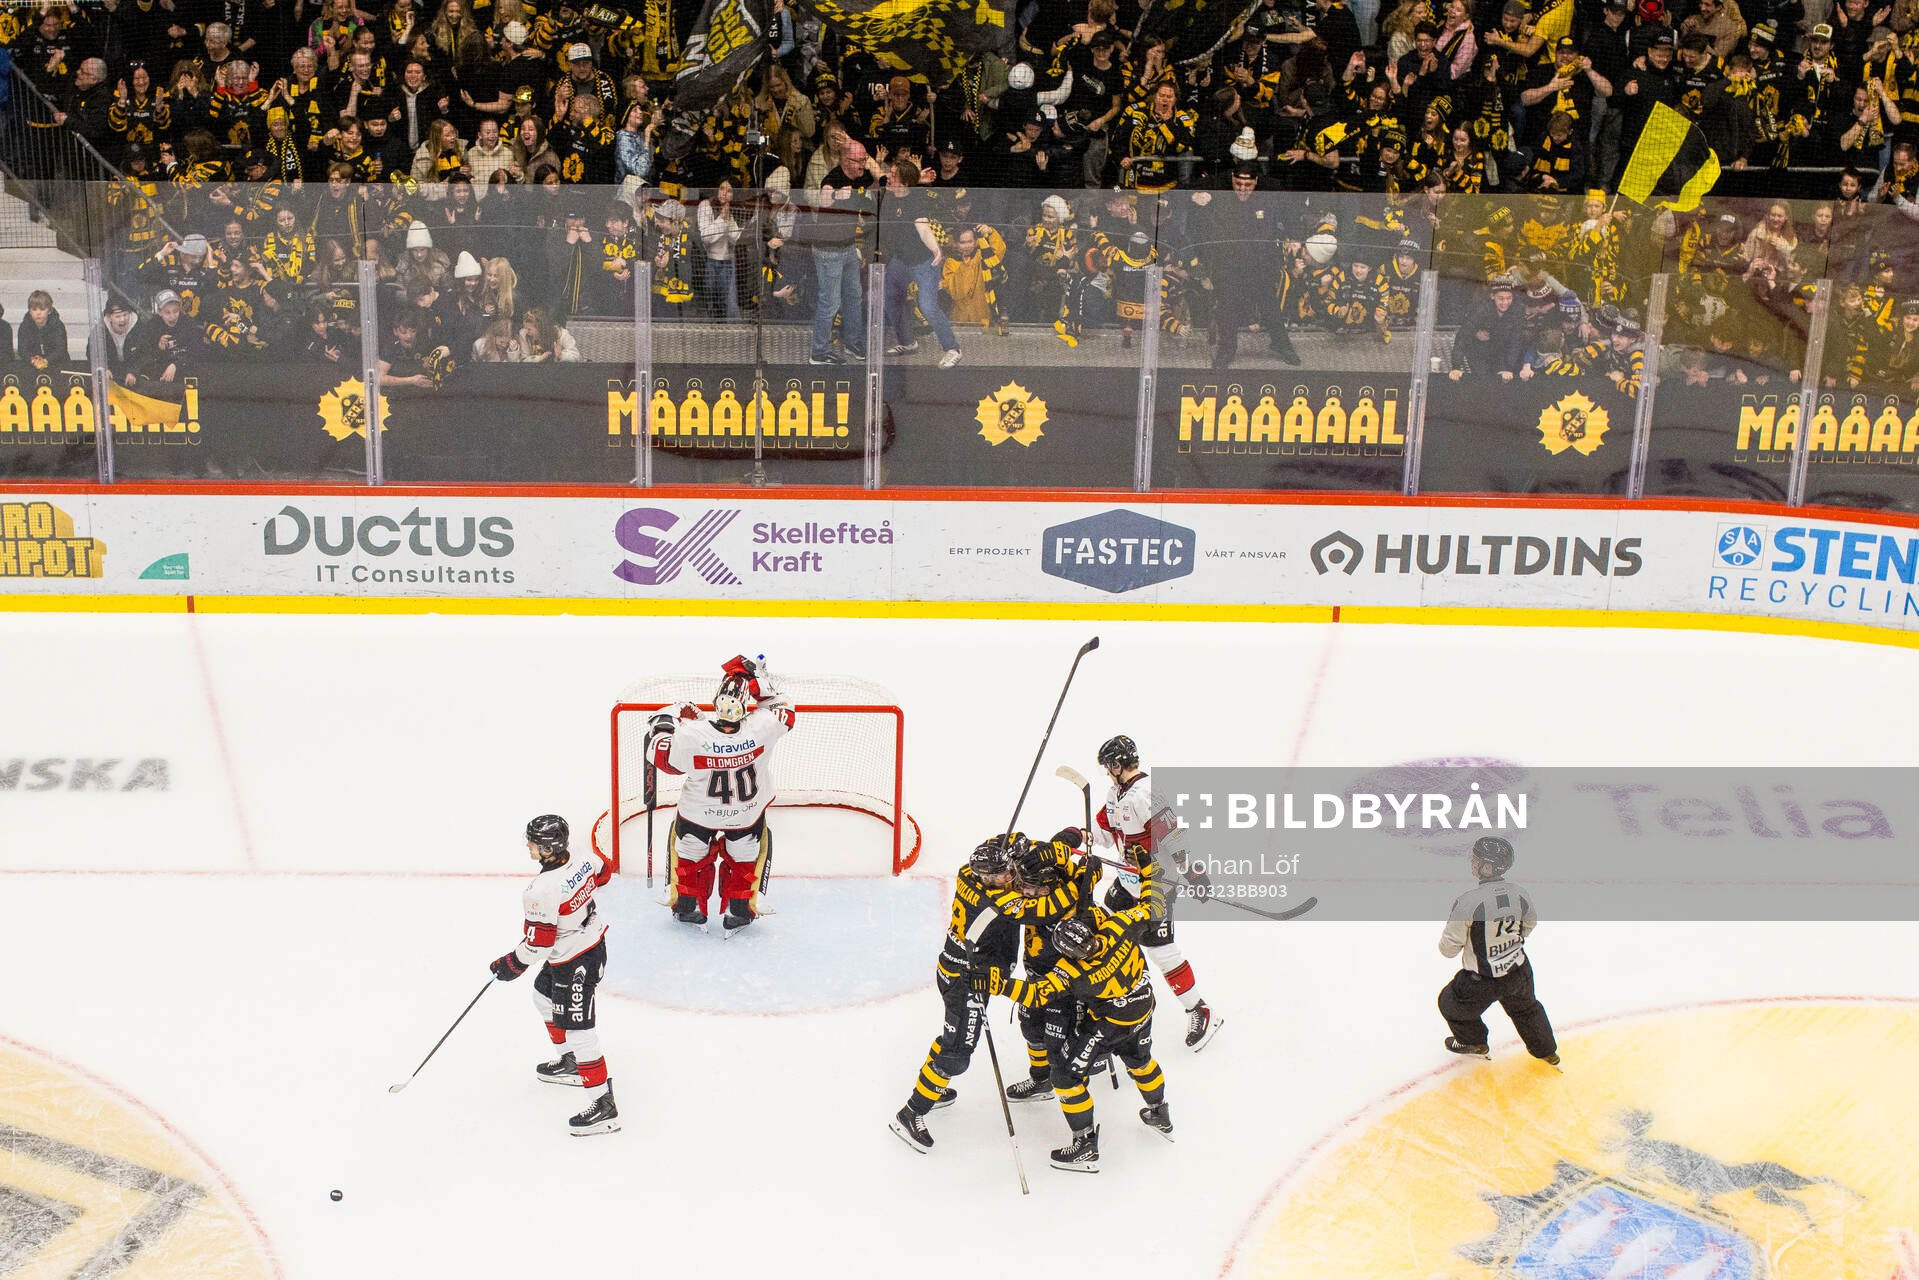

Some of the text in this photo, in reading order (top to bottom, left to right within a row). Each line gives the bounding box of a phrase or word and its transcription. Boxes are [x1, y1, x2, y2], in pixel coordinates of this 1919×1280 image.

[752, 520, 894, 545] Skellefteå
[752, 551, 823, 573] Kraft
[949, 547, 1032, 556] ERT PROJEKT
[1055, 537, 1183, 567] FASTEC
[1205, 548, 1287, 559] VÅRT ANSVAR
[1374, 534, 1643, 577] HULTDINS
[1771, 526, 1919, 585] STEN
[317, 564, 515, 584] IT Consultants
[706, 752, 755, 769] BLOMGREN
[712, 739, 756, 754] bravida
[708, 763, 759, 804] 40
[1572, 783, 1895, 840] Telia
[566, 861, 593, 890] bravida
[1494, 915, 1516, 938] 72
[1096, 945, 1146, 999] 43
[568, 983, 583, 1022] akea
[965, 1009, 979, 1047] REPAY
